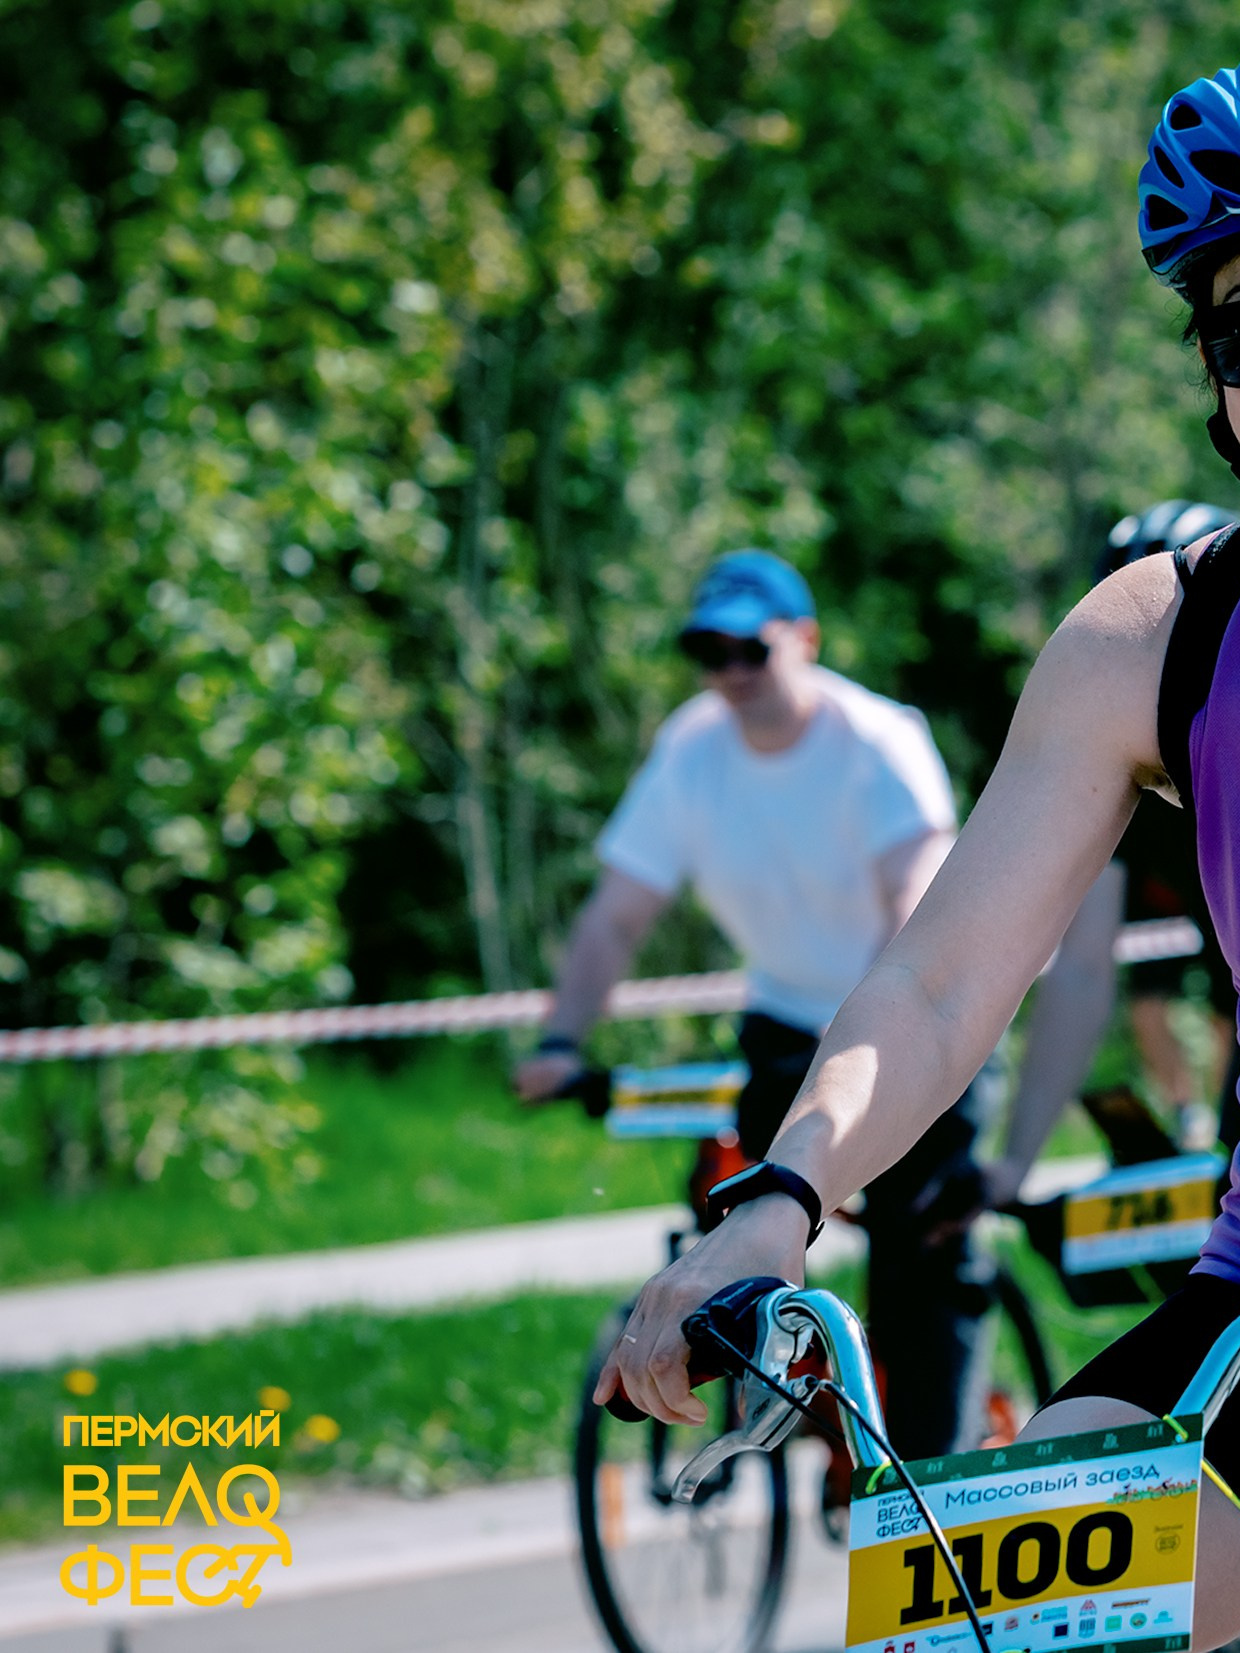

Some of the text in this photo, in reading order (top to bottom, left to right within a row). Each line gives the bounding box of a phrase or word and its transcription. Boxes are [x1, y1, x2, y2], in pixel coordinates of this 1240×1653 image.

[944, 1462, 1161, 1510] Массовый заезд
[900, 1510, 1133, 1626] 1100
